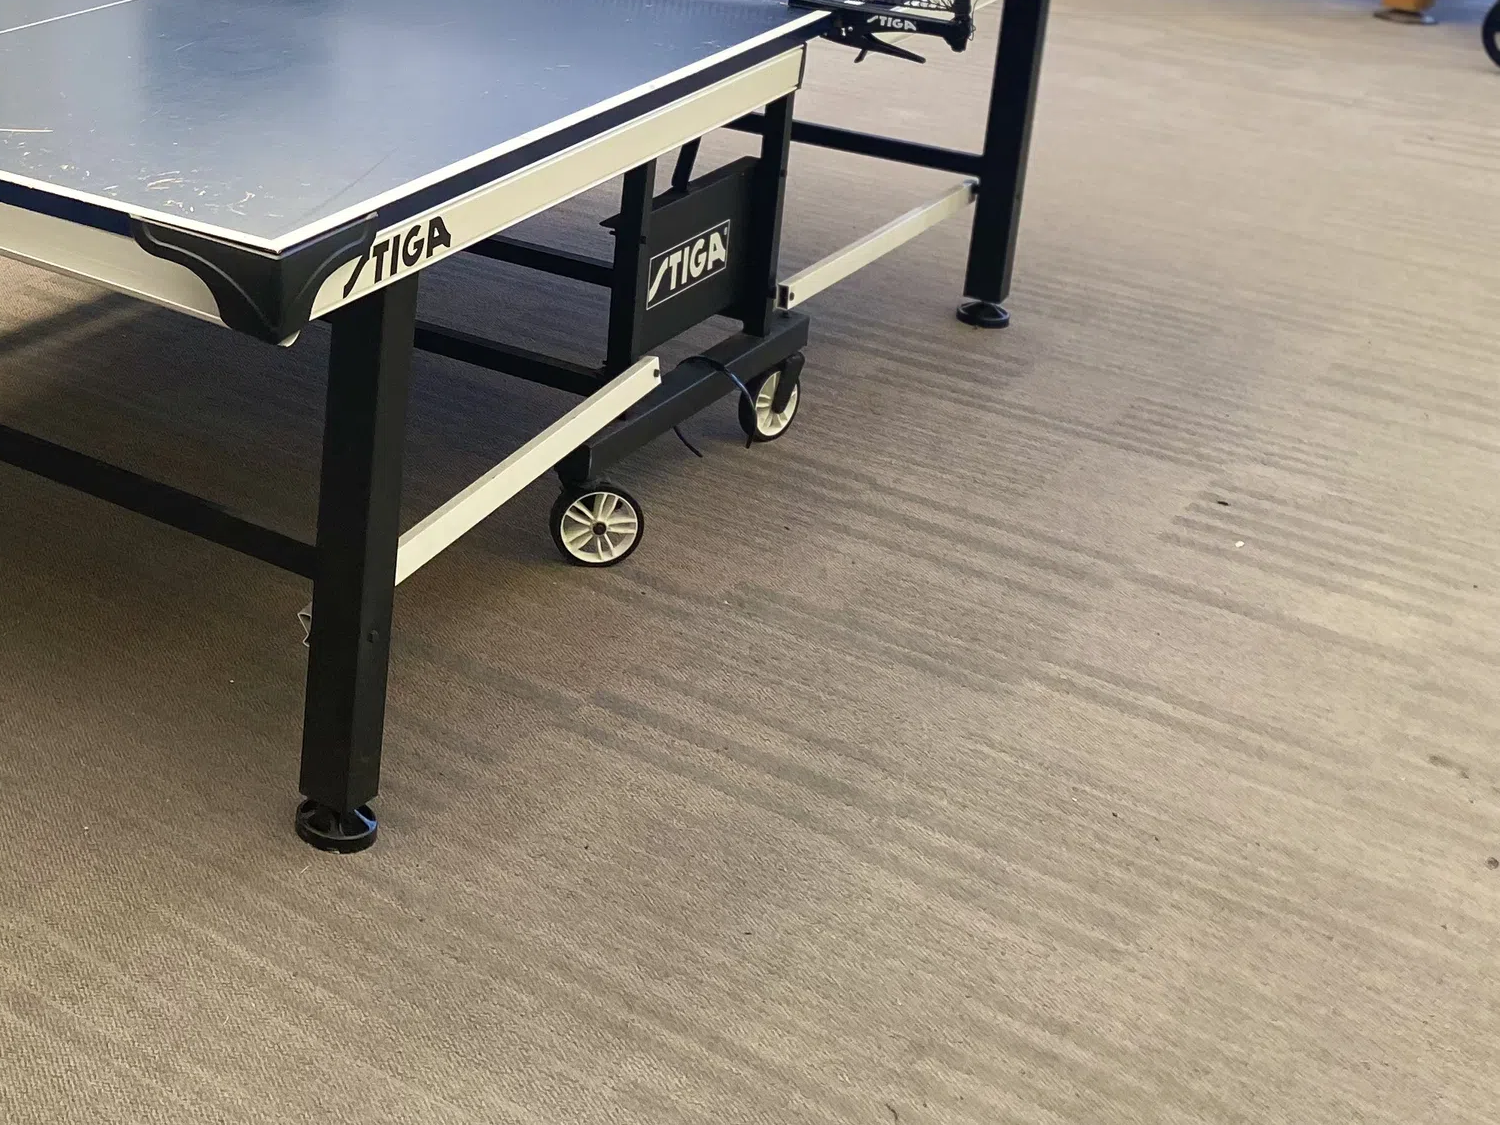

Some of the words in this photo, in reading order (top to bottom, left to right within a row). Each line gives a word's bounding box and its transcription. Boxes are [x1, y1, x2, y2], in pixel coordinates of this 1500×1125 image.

[867, 15, 916, 31] STIGA
[343, 216, 451, 299] STIGA
[648, 231, 726, 303] STIGA
